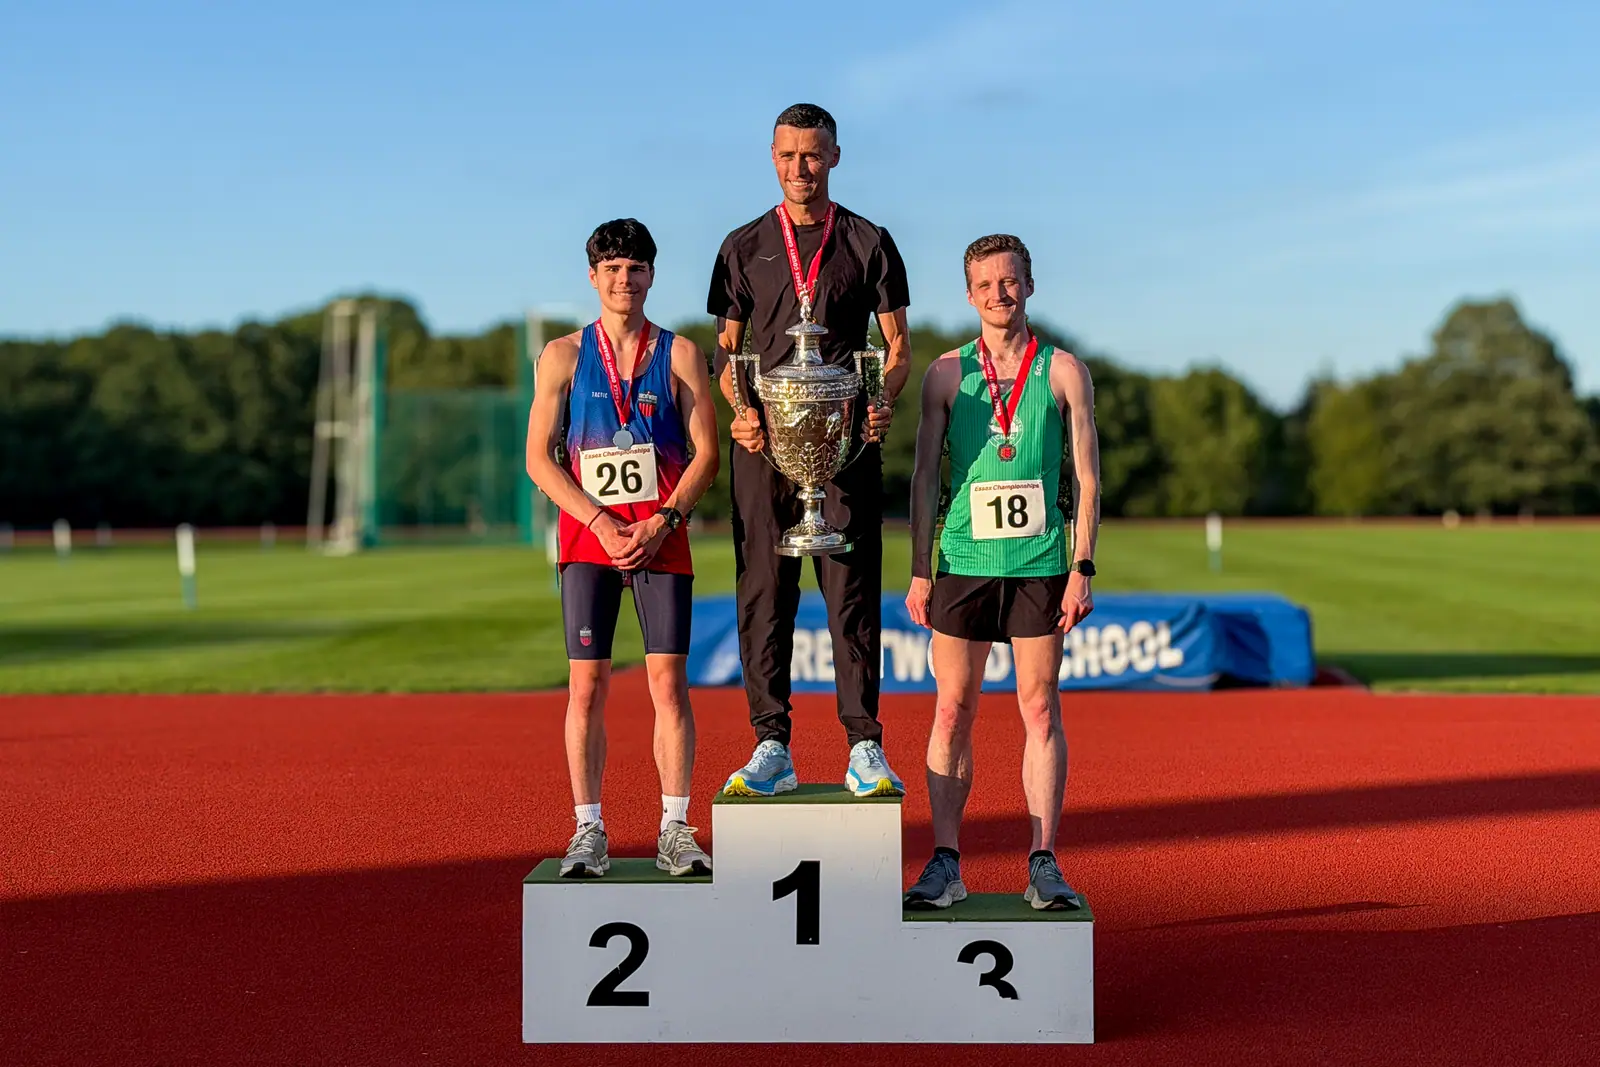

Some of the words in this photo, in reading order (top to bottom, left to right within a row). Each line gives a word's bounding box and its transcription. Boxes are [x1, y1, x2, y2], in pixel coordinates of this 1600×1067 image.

[591, 391, 608, 399] TACTIC
[584, 452, 602, 460] Essex
[596, 459, 643, 497] 26
[993, 482, 1040, 491] Championships
[986, 493, 1029, 529] 18
[771, 860, 821, 946] 1
[585, 921, 650, 1008] 2
[956, 938, 1019, 1001] 3
